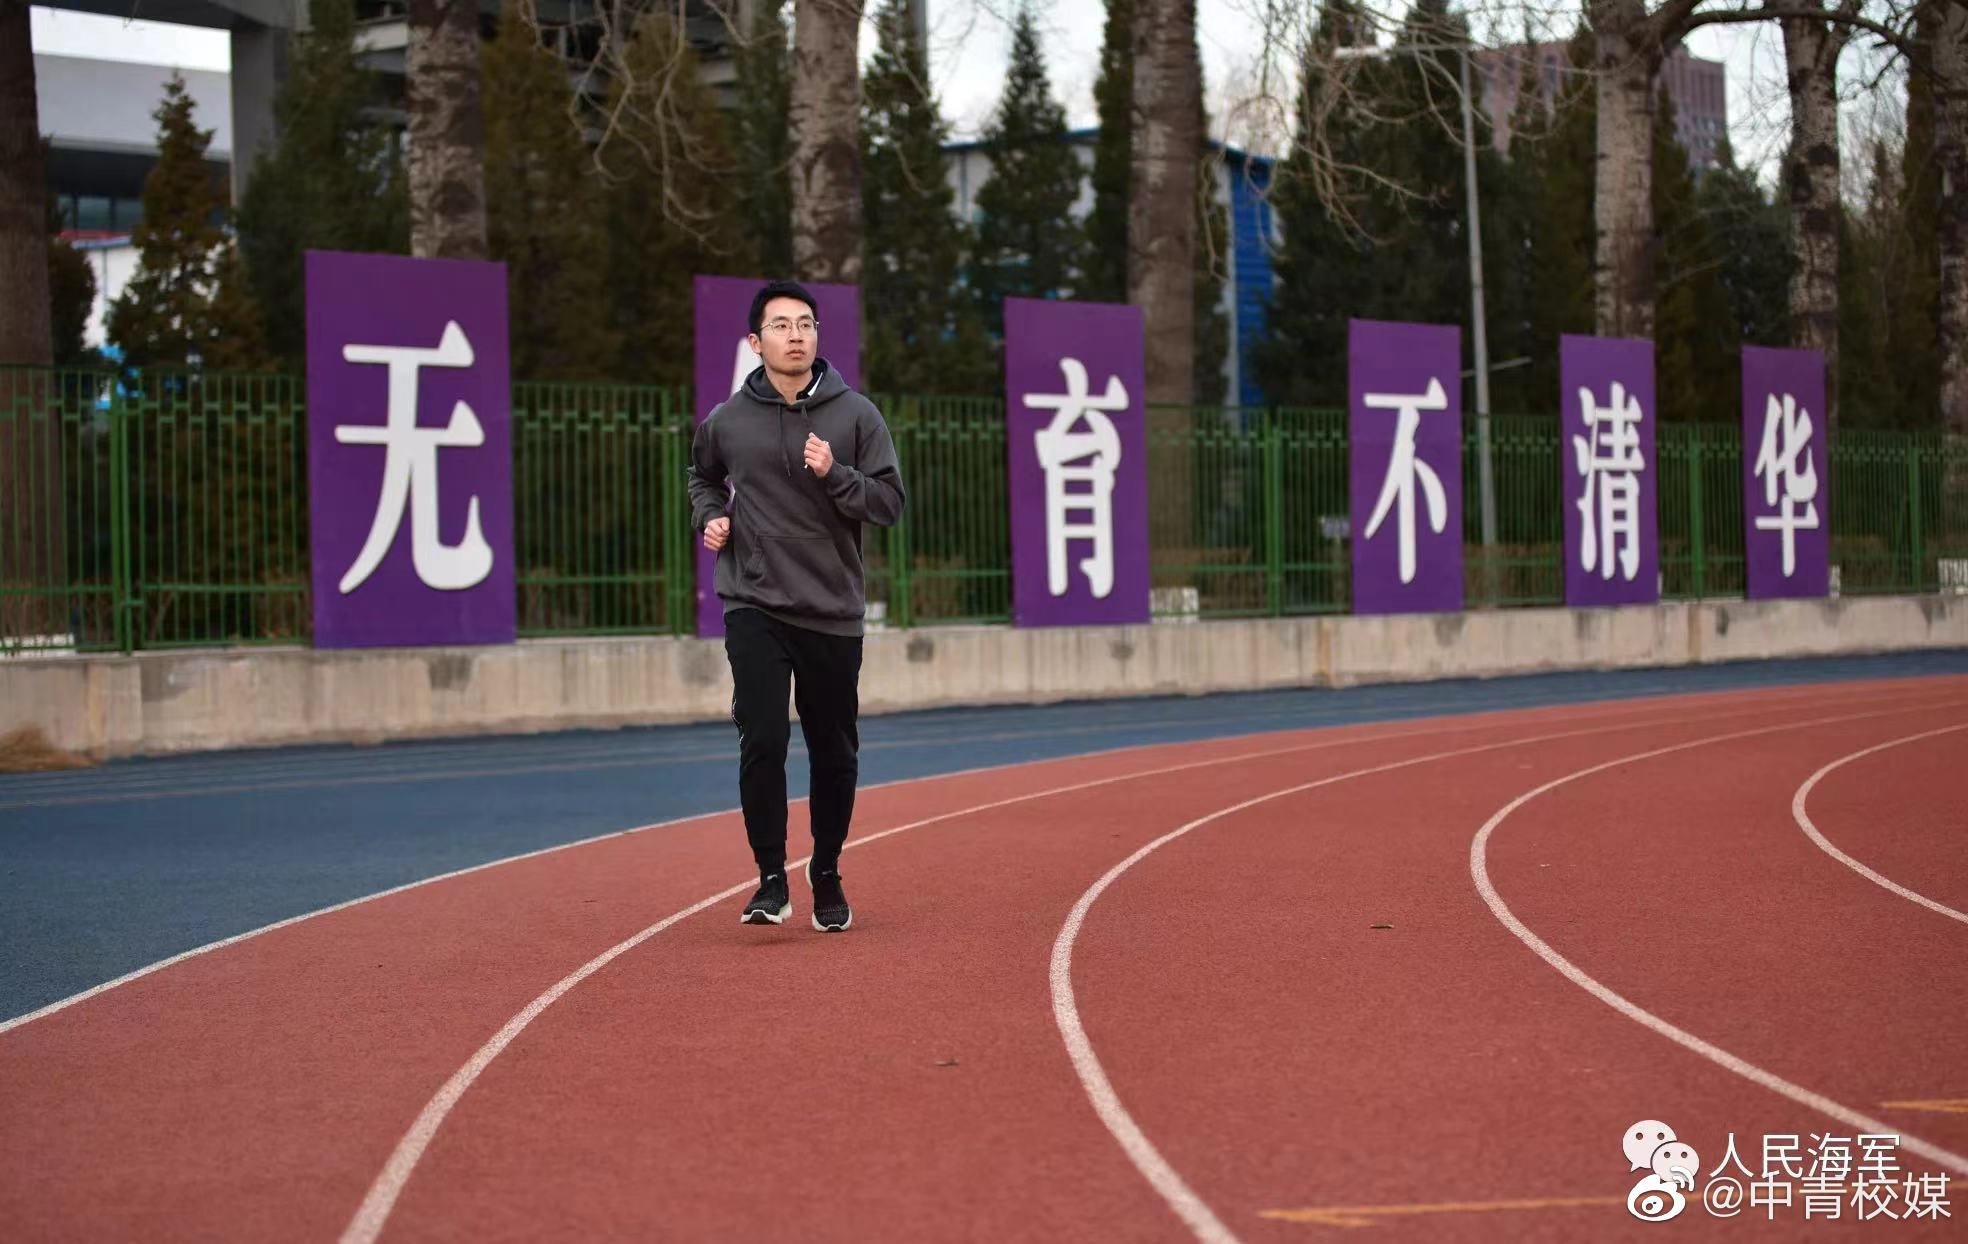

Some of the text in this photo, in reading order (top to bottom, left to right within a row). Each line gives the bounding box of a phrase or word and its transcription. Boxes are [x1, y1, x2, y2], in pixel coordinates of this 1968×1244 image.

[334, 320, 493, 593] 无
[1023, 357, 1129, 598] 育
[1363, 377, 1448, 584] 不
[1573, 381, 1645, 581] 清
[1754, 393, 1819, 577] 华
